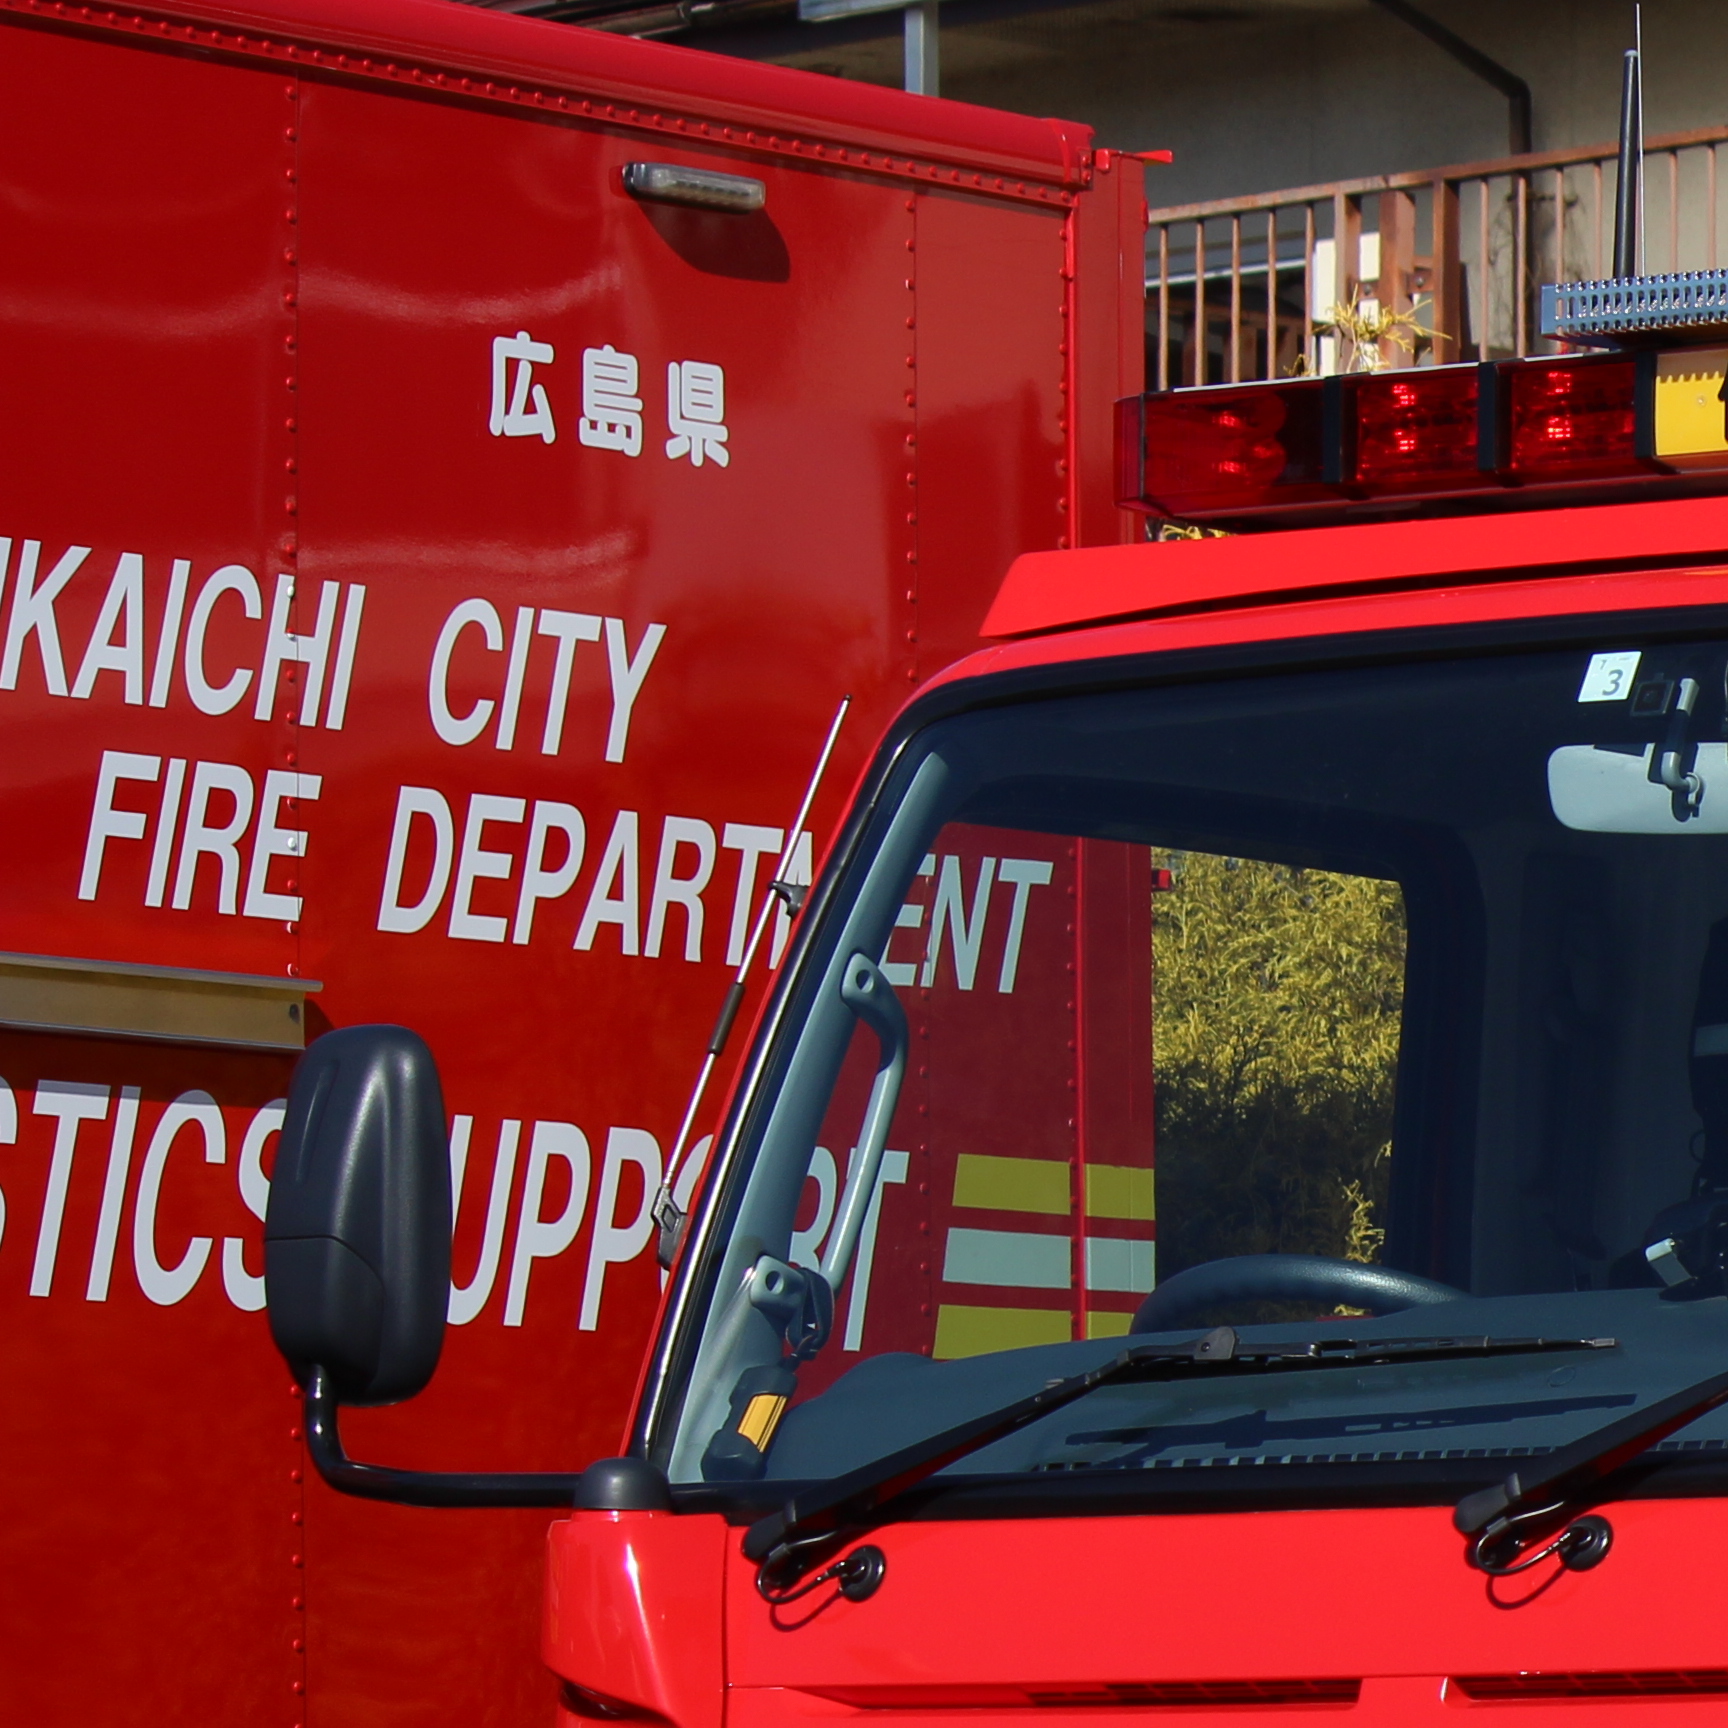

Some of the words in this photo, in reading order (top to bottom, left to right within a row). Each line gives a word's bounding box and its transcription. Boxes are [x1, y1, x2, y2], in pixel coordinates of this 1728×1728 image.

[489, 331, 729, 468] 広島県
[0, 536, 366, 730] KAICHI
[429, 598, 667, 763] CITY
[1601, 669, 1624, 697] 3
[78, 750, 322, 922] FIRE
[0, 1075, 288, 1312] TICS
